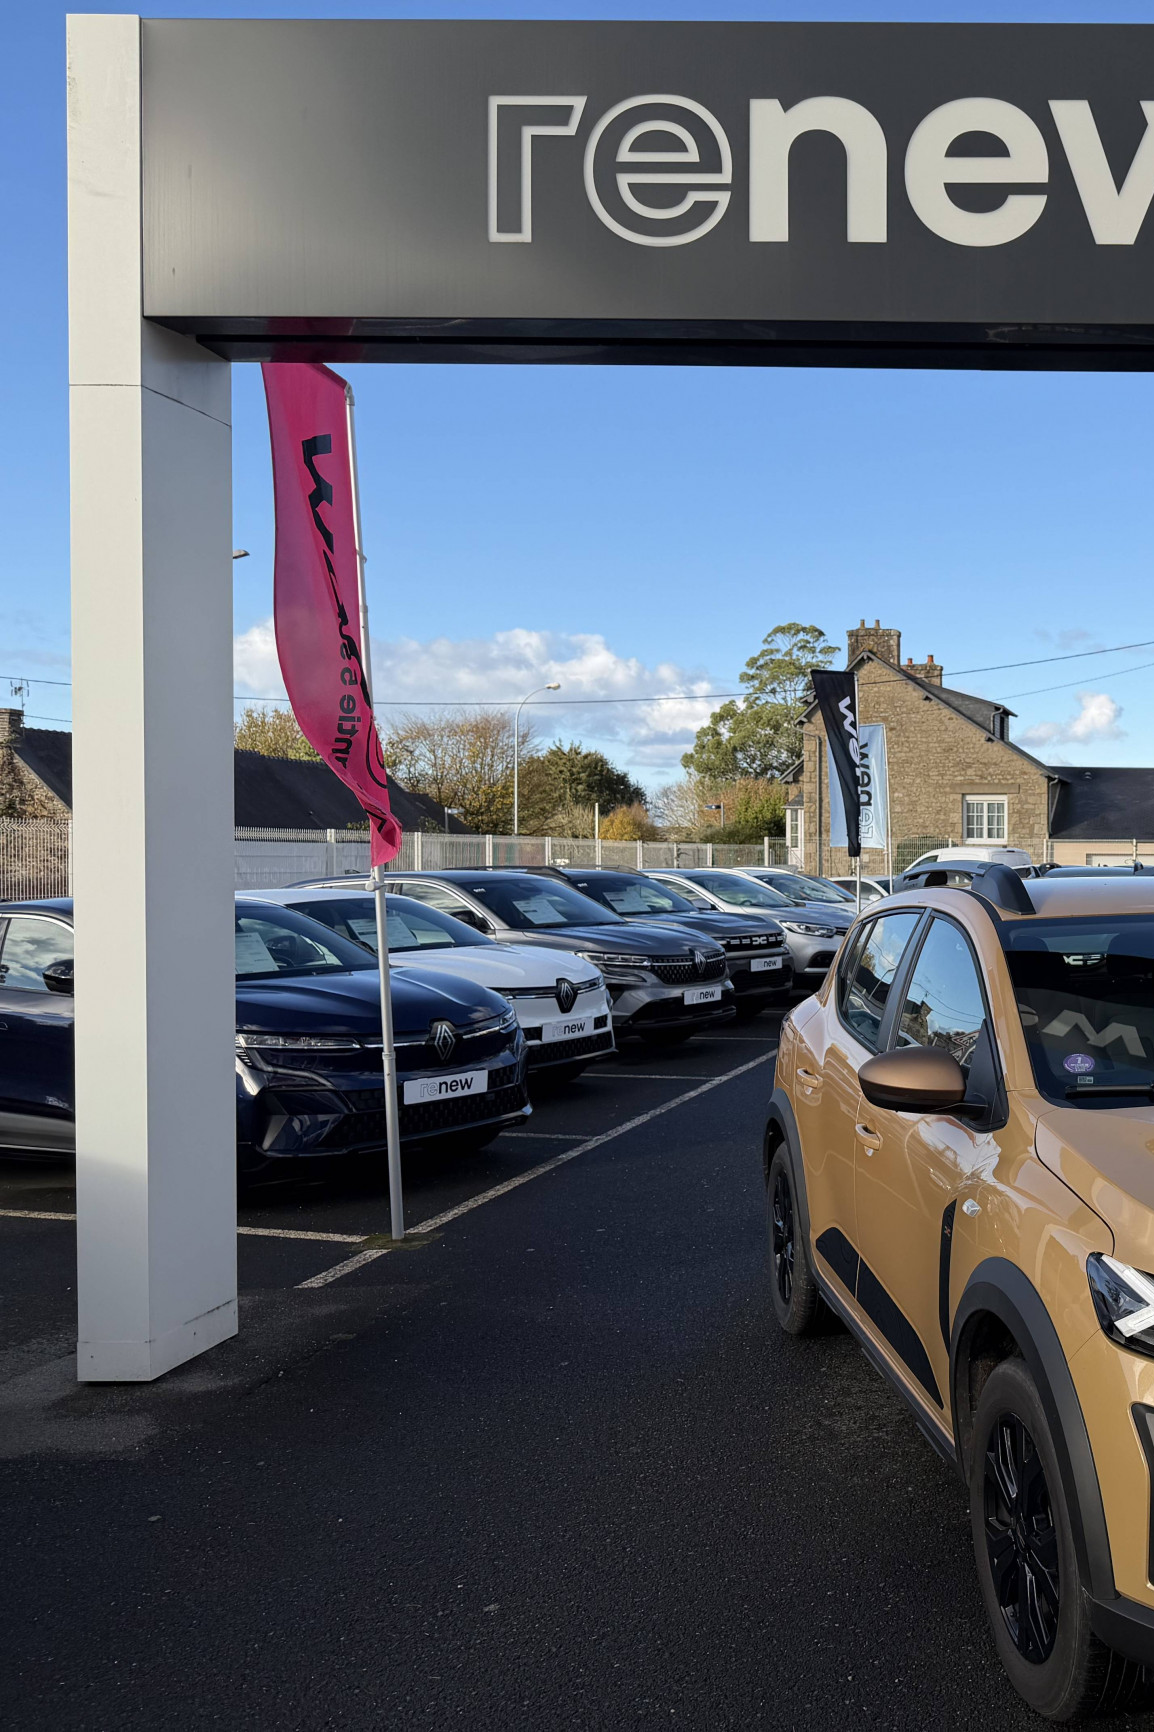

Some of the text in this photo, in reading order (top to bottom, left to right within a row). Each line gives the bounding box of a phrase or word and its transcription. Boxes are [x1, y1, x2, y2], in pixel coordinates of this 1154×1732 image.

[691, 989, 716, 1004] new
[551, 1021, 586, 1038] renew
[420, 1077, 474, 1098] renew
